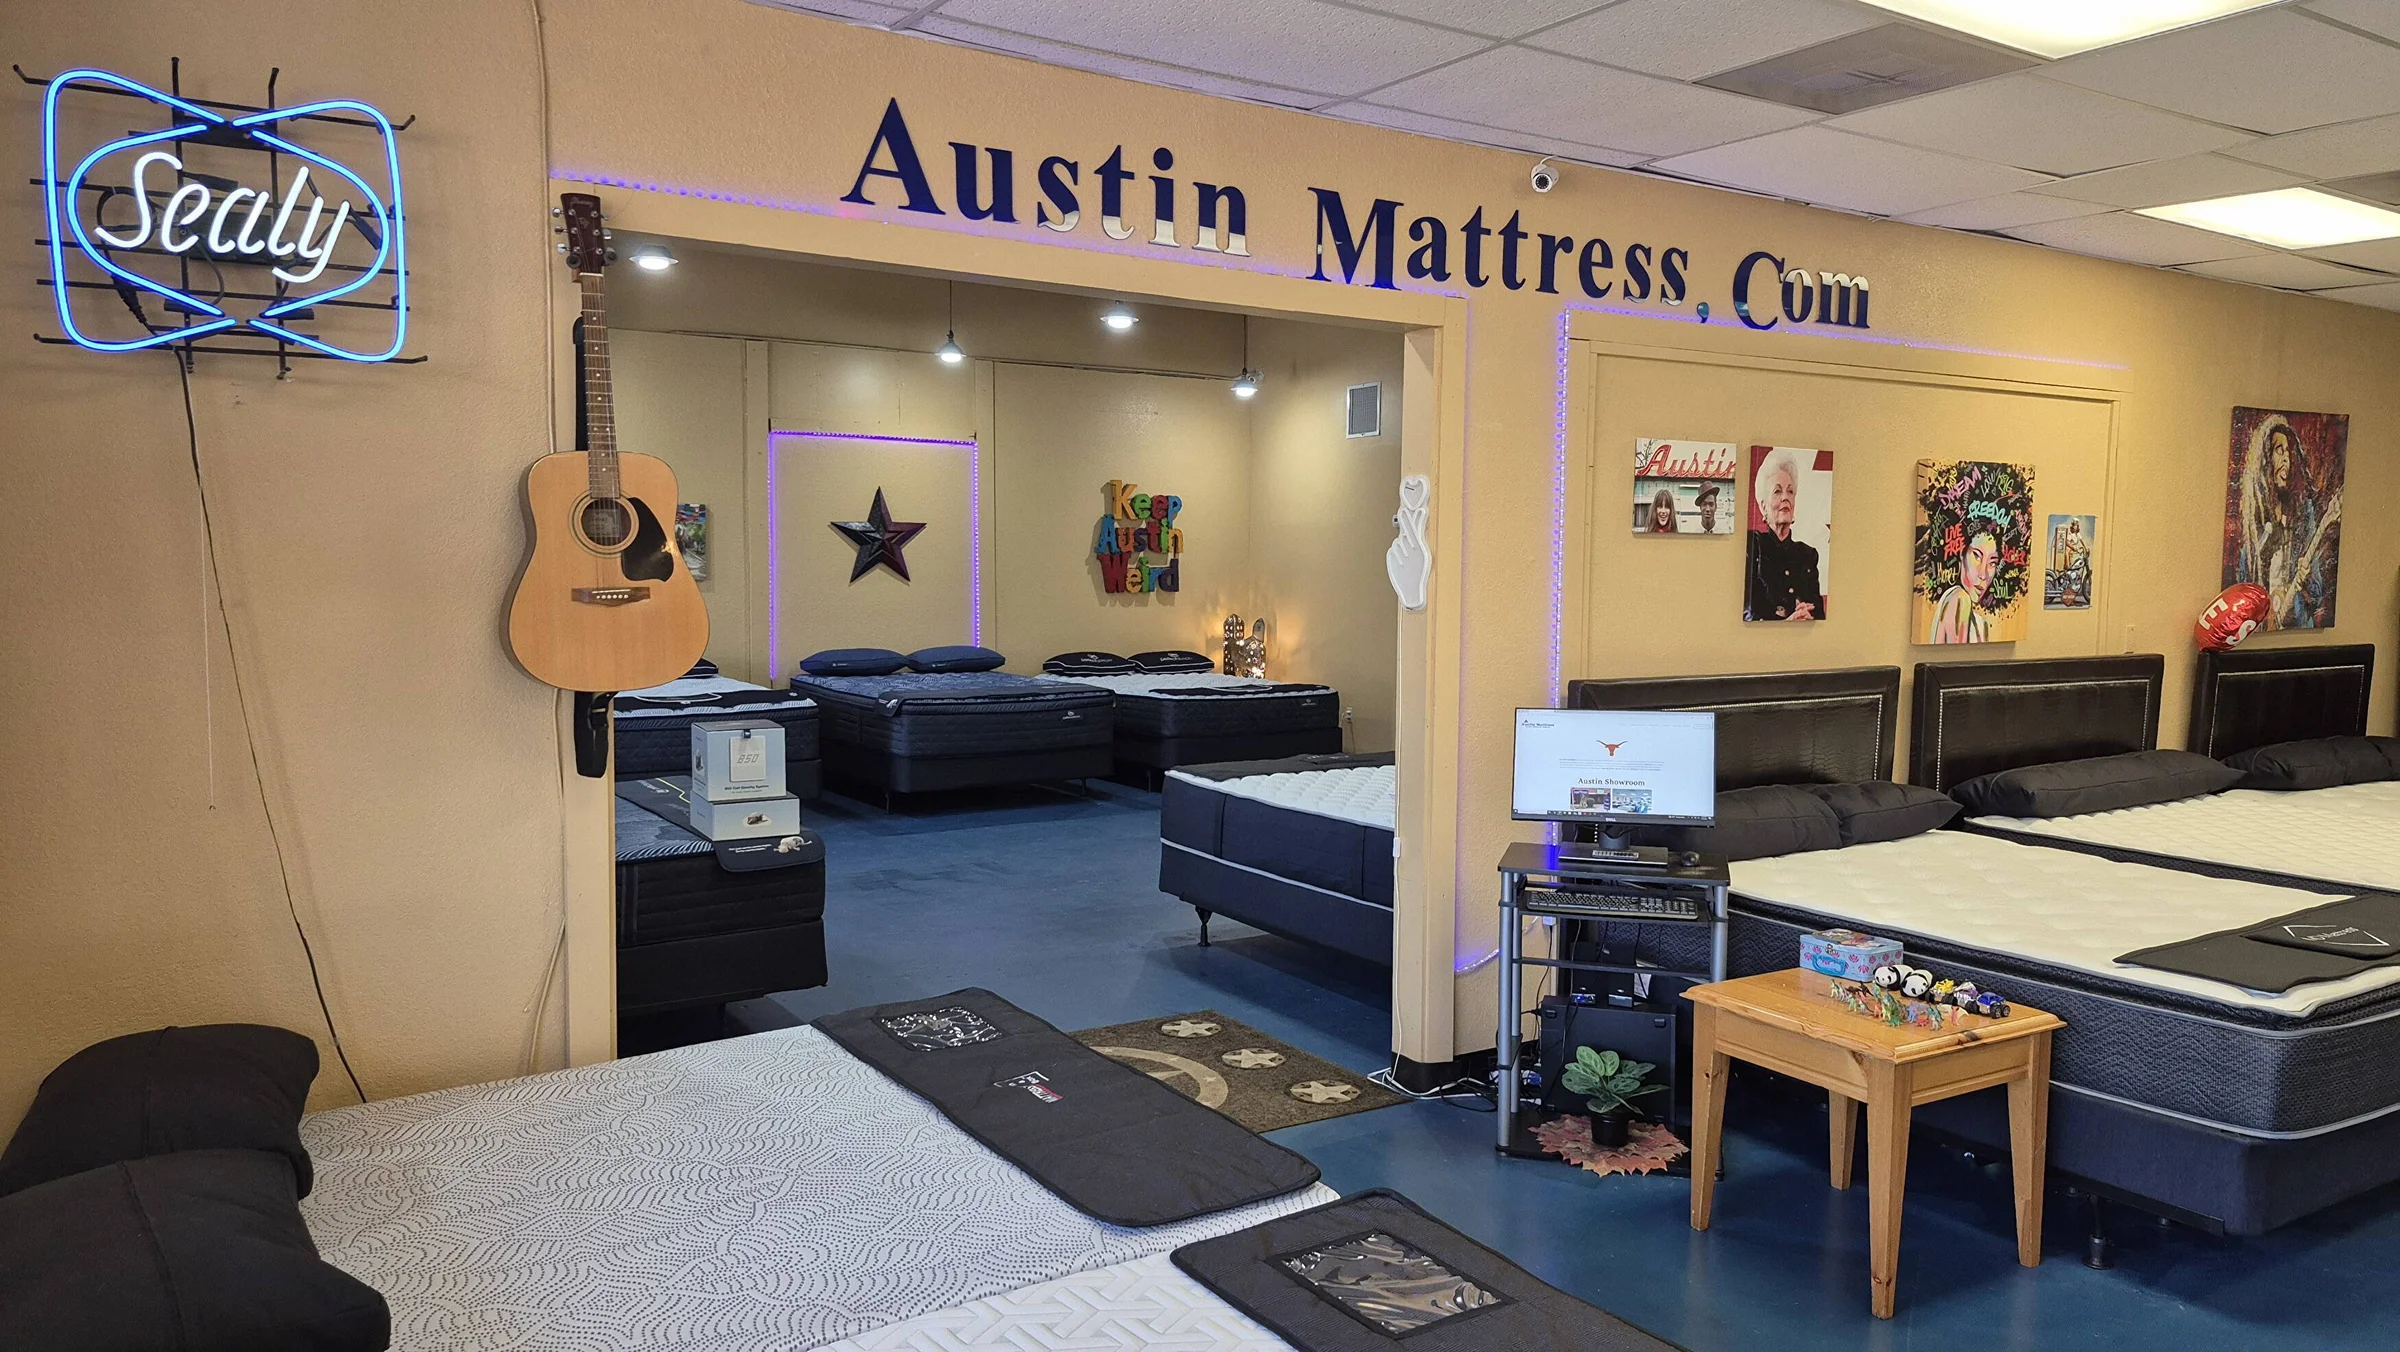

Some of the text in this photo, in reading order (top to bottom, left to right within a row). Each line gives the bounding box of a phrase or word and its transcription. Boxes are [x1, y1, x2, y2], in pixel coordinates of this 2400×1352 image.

[94, 151, 351, 283] Sealy
[840, 97, 1251, 258] Austin
[1733, 251, 1871, 331] Com
[1110, 480, 1182, 529] Keep
[1095, 513, 1184, 554] Austin
[1944, 537, 1966, 561] FREE
[1097, 551, 1180, 594] Weird
[1578, 777, 1646, 787] Austin Showroom
